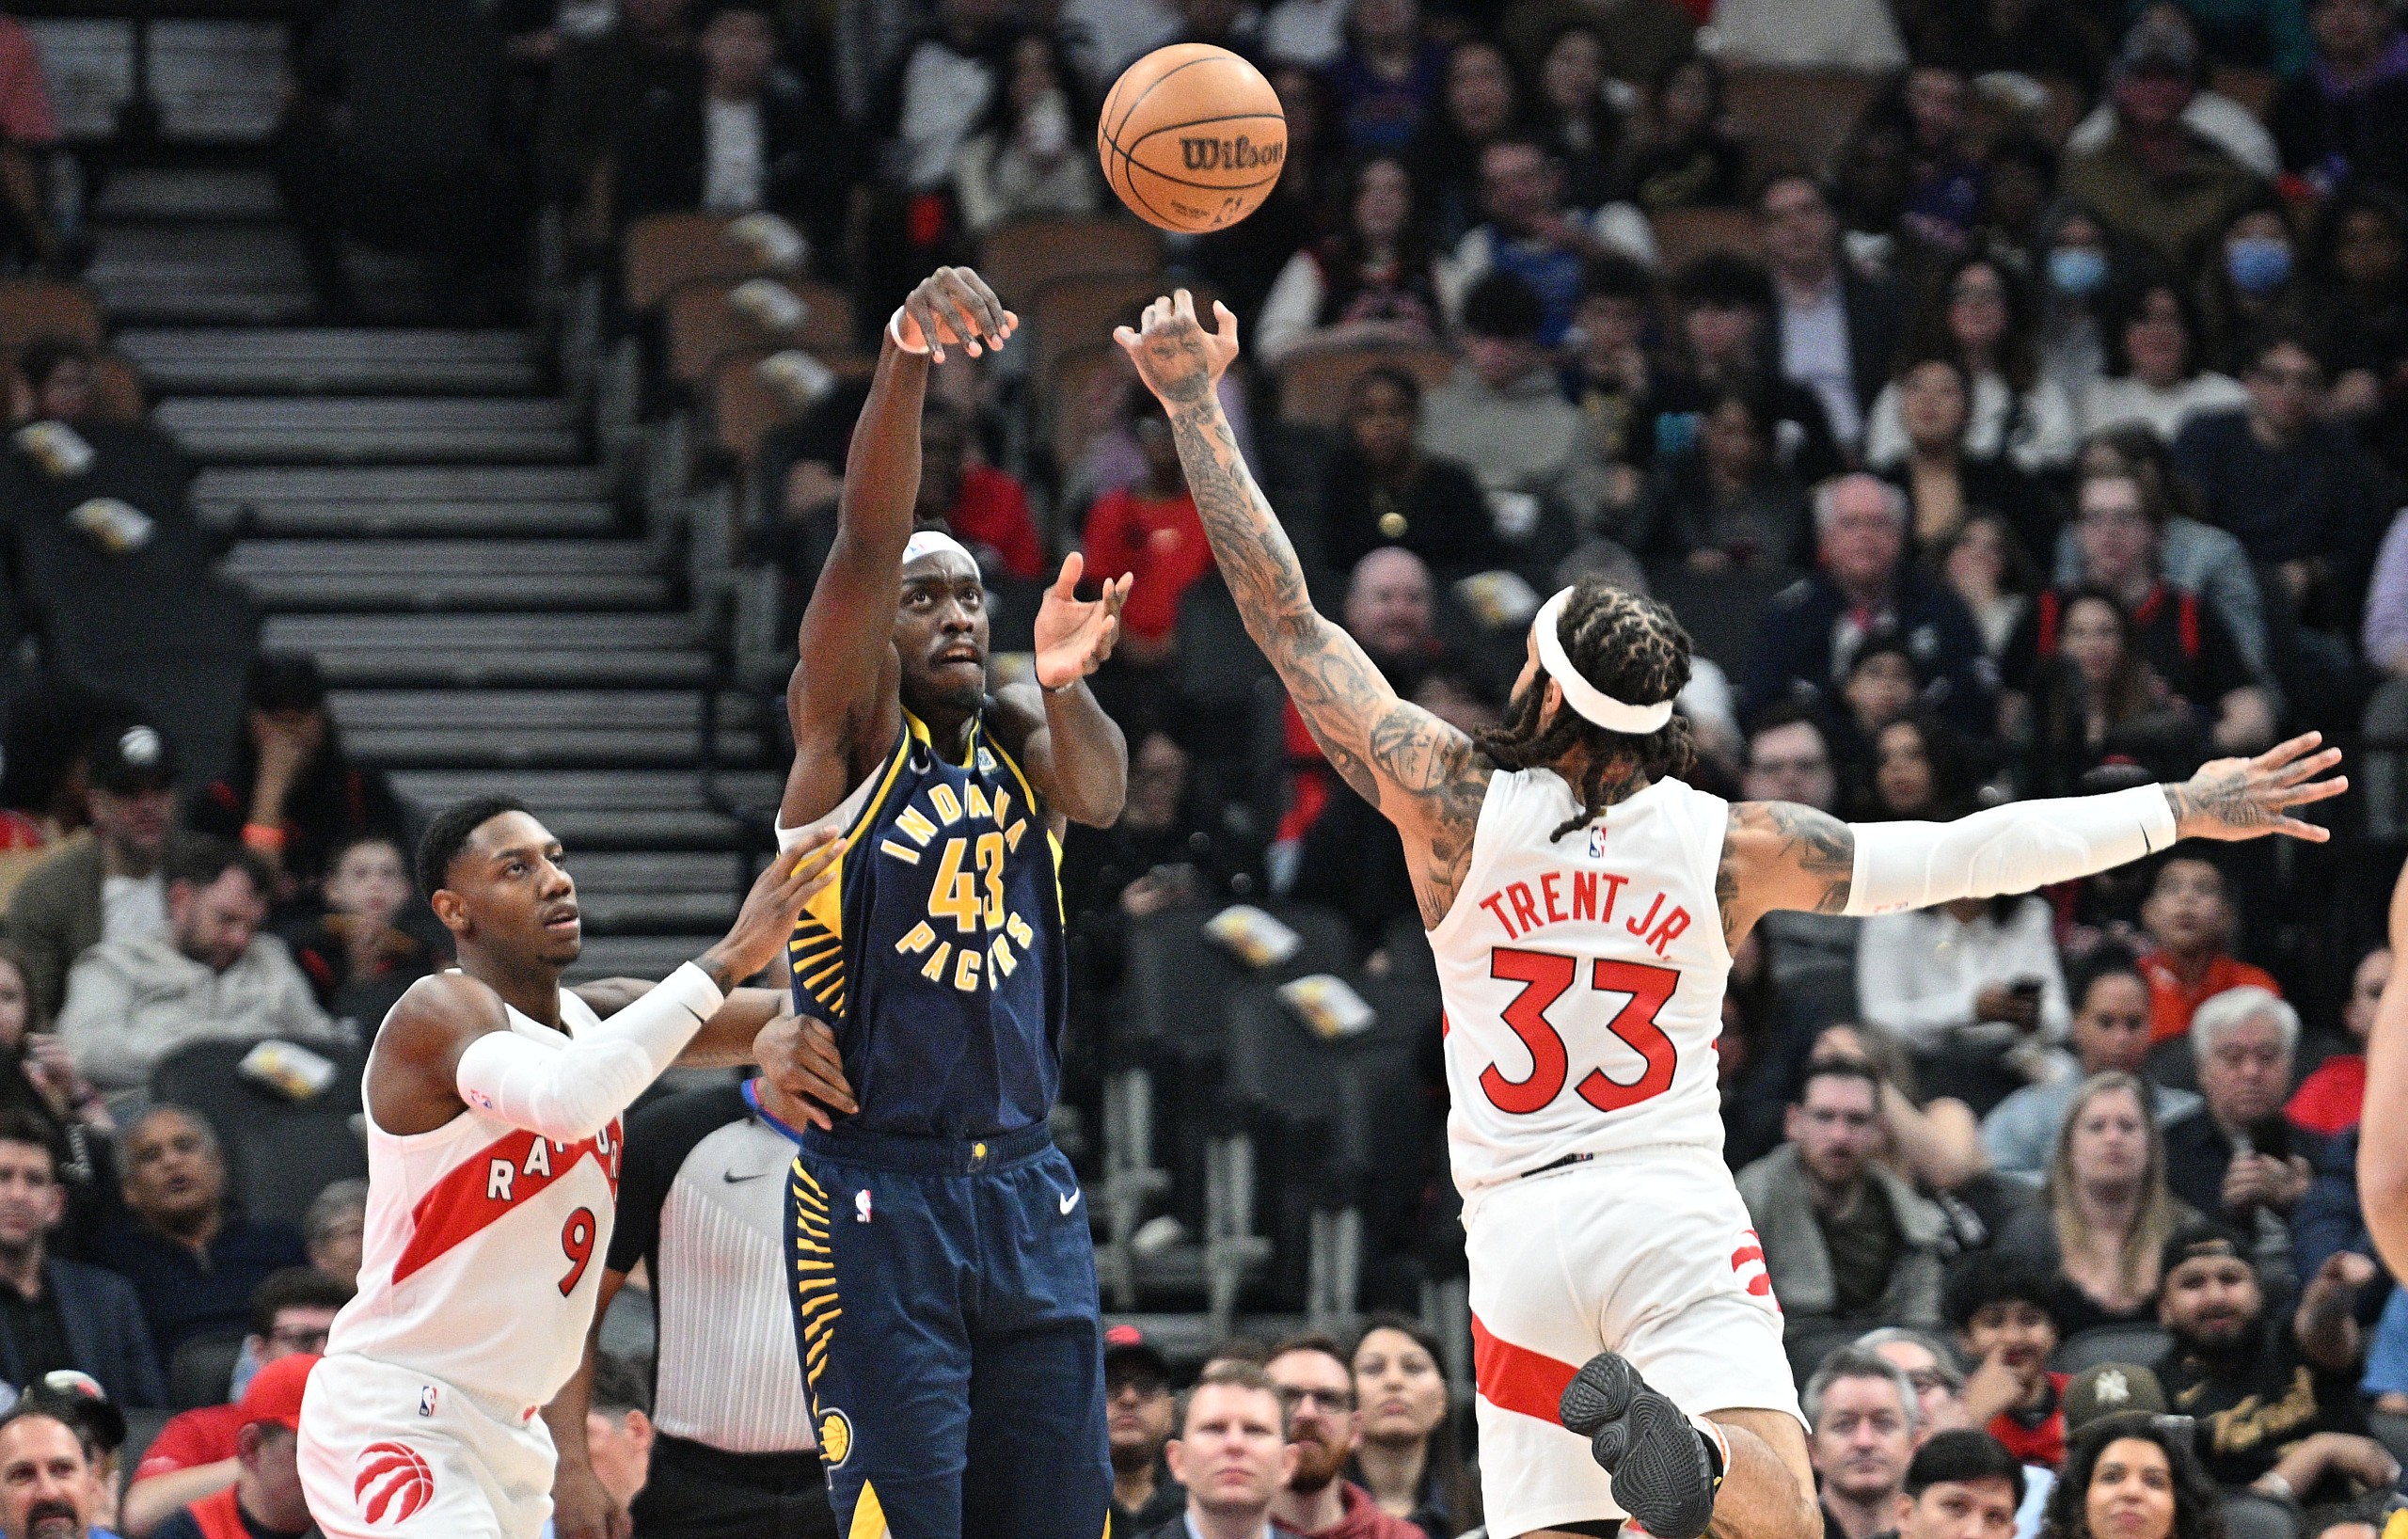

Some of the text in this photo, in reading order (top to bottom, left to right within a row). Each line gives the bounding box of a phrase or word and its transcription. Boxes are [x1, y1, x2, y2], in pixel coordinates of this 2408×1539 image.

[1180, 135, 1284, 170] Wilson
[927, 831, 1005, 932] 43
[1479, 870, 1691, 960] TRENT JR.
[1479, 945, 1682, 1115] 33
[558, 1206, 596, 1298] 9
